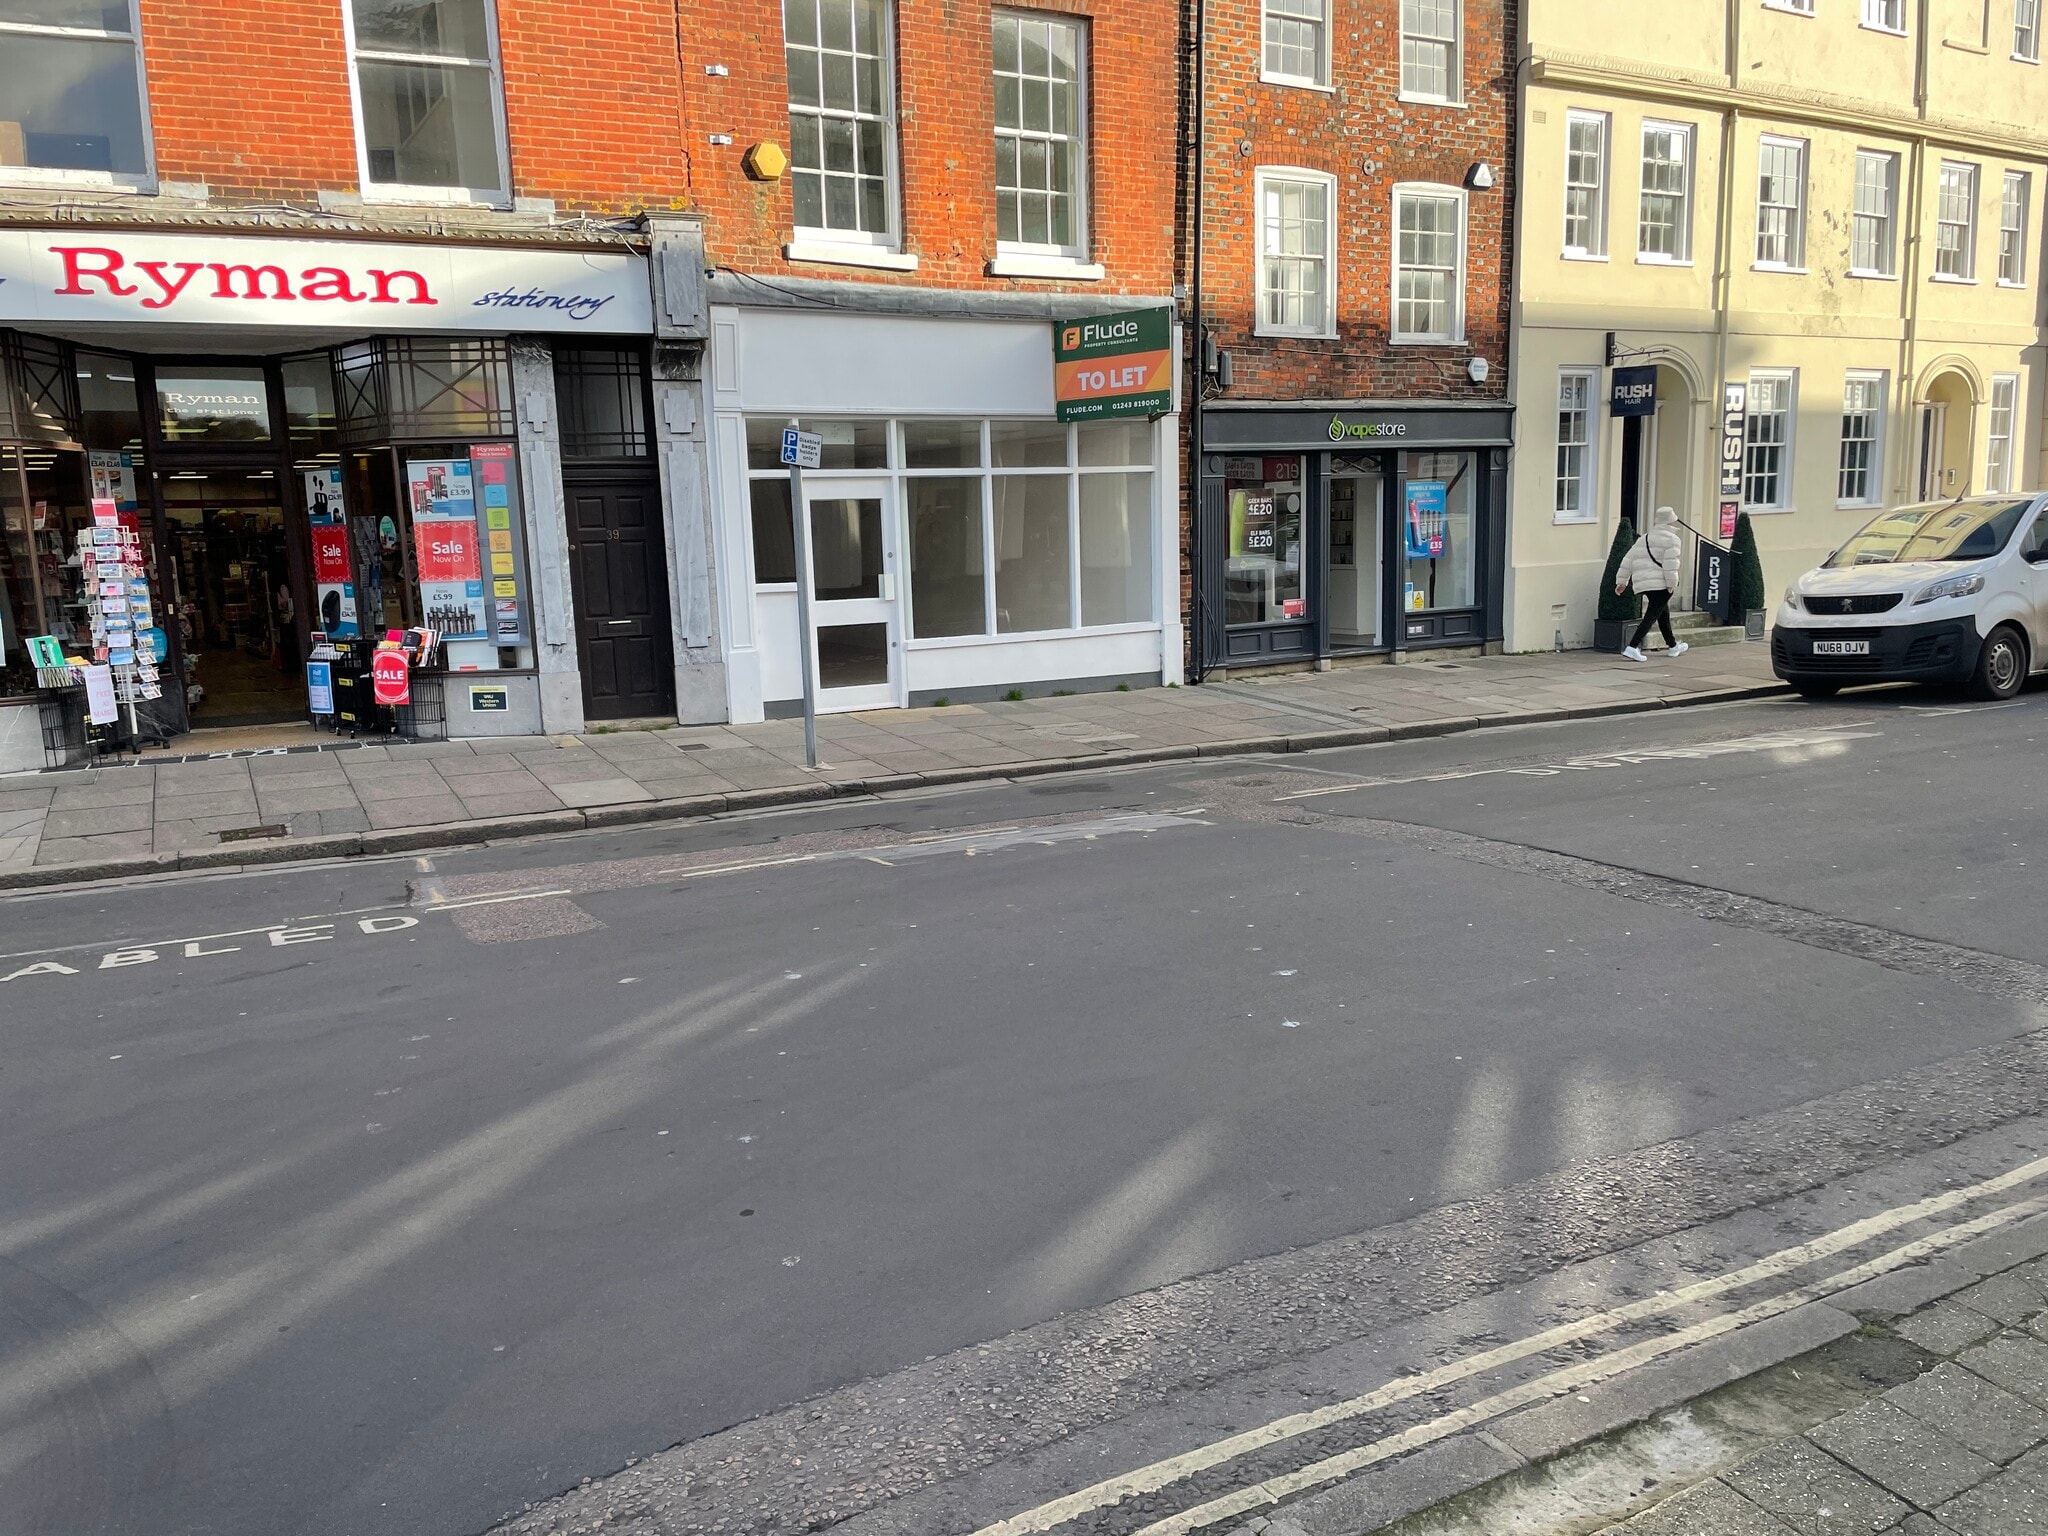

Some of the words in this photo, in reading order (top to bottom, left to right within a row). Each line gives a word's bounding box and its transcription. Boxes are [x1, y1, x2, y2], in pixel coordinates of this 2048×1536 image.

[48, 246, 438, 309] Ryman
[472, 286, 615, 320] stationery
[1084, 320, 1138, 342] Flude
[1107, 337, 1138, 346] CONSULTANTS
[1077, 371, 1106, 391] TO
[1110, 366, 1147, 388] LET
[1615, 384, 1653, 399] RUSH
[165, 392, 260, 406] Ryman
[1066, 404, 1103, 414] FLUDE.COM
[1112, 401, 1132, 410] 01243
[1134, 398, 1160, 408] 819000
[1345, 422, 1406, 440] vapestore
[1722, 386, 1745, 485] RUSH
[787, 432, 797, 445] P
[799, 437, 820, 446] Disabled
[606, 529, 620, 540] 39
[322, 544, 342, 557] Sale
[432, 540, 463, 554] Sale
[335, 557, 343, 565] On
[433, 555, 451, 563] Now
[453, 554, 465, 563] On
[1708, 556, 1720, 600] RUSH
[433, 593, 453, 601] £5.99
[1817, 642, 1842, 653] NU68
[1844, 642, 1865, 653] OJV
[376, 670, 405, 680] SALE
